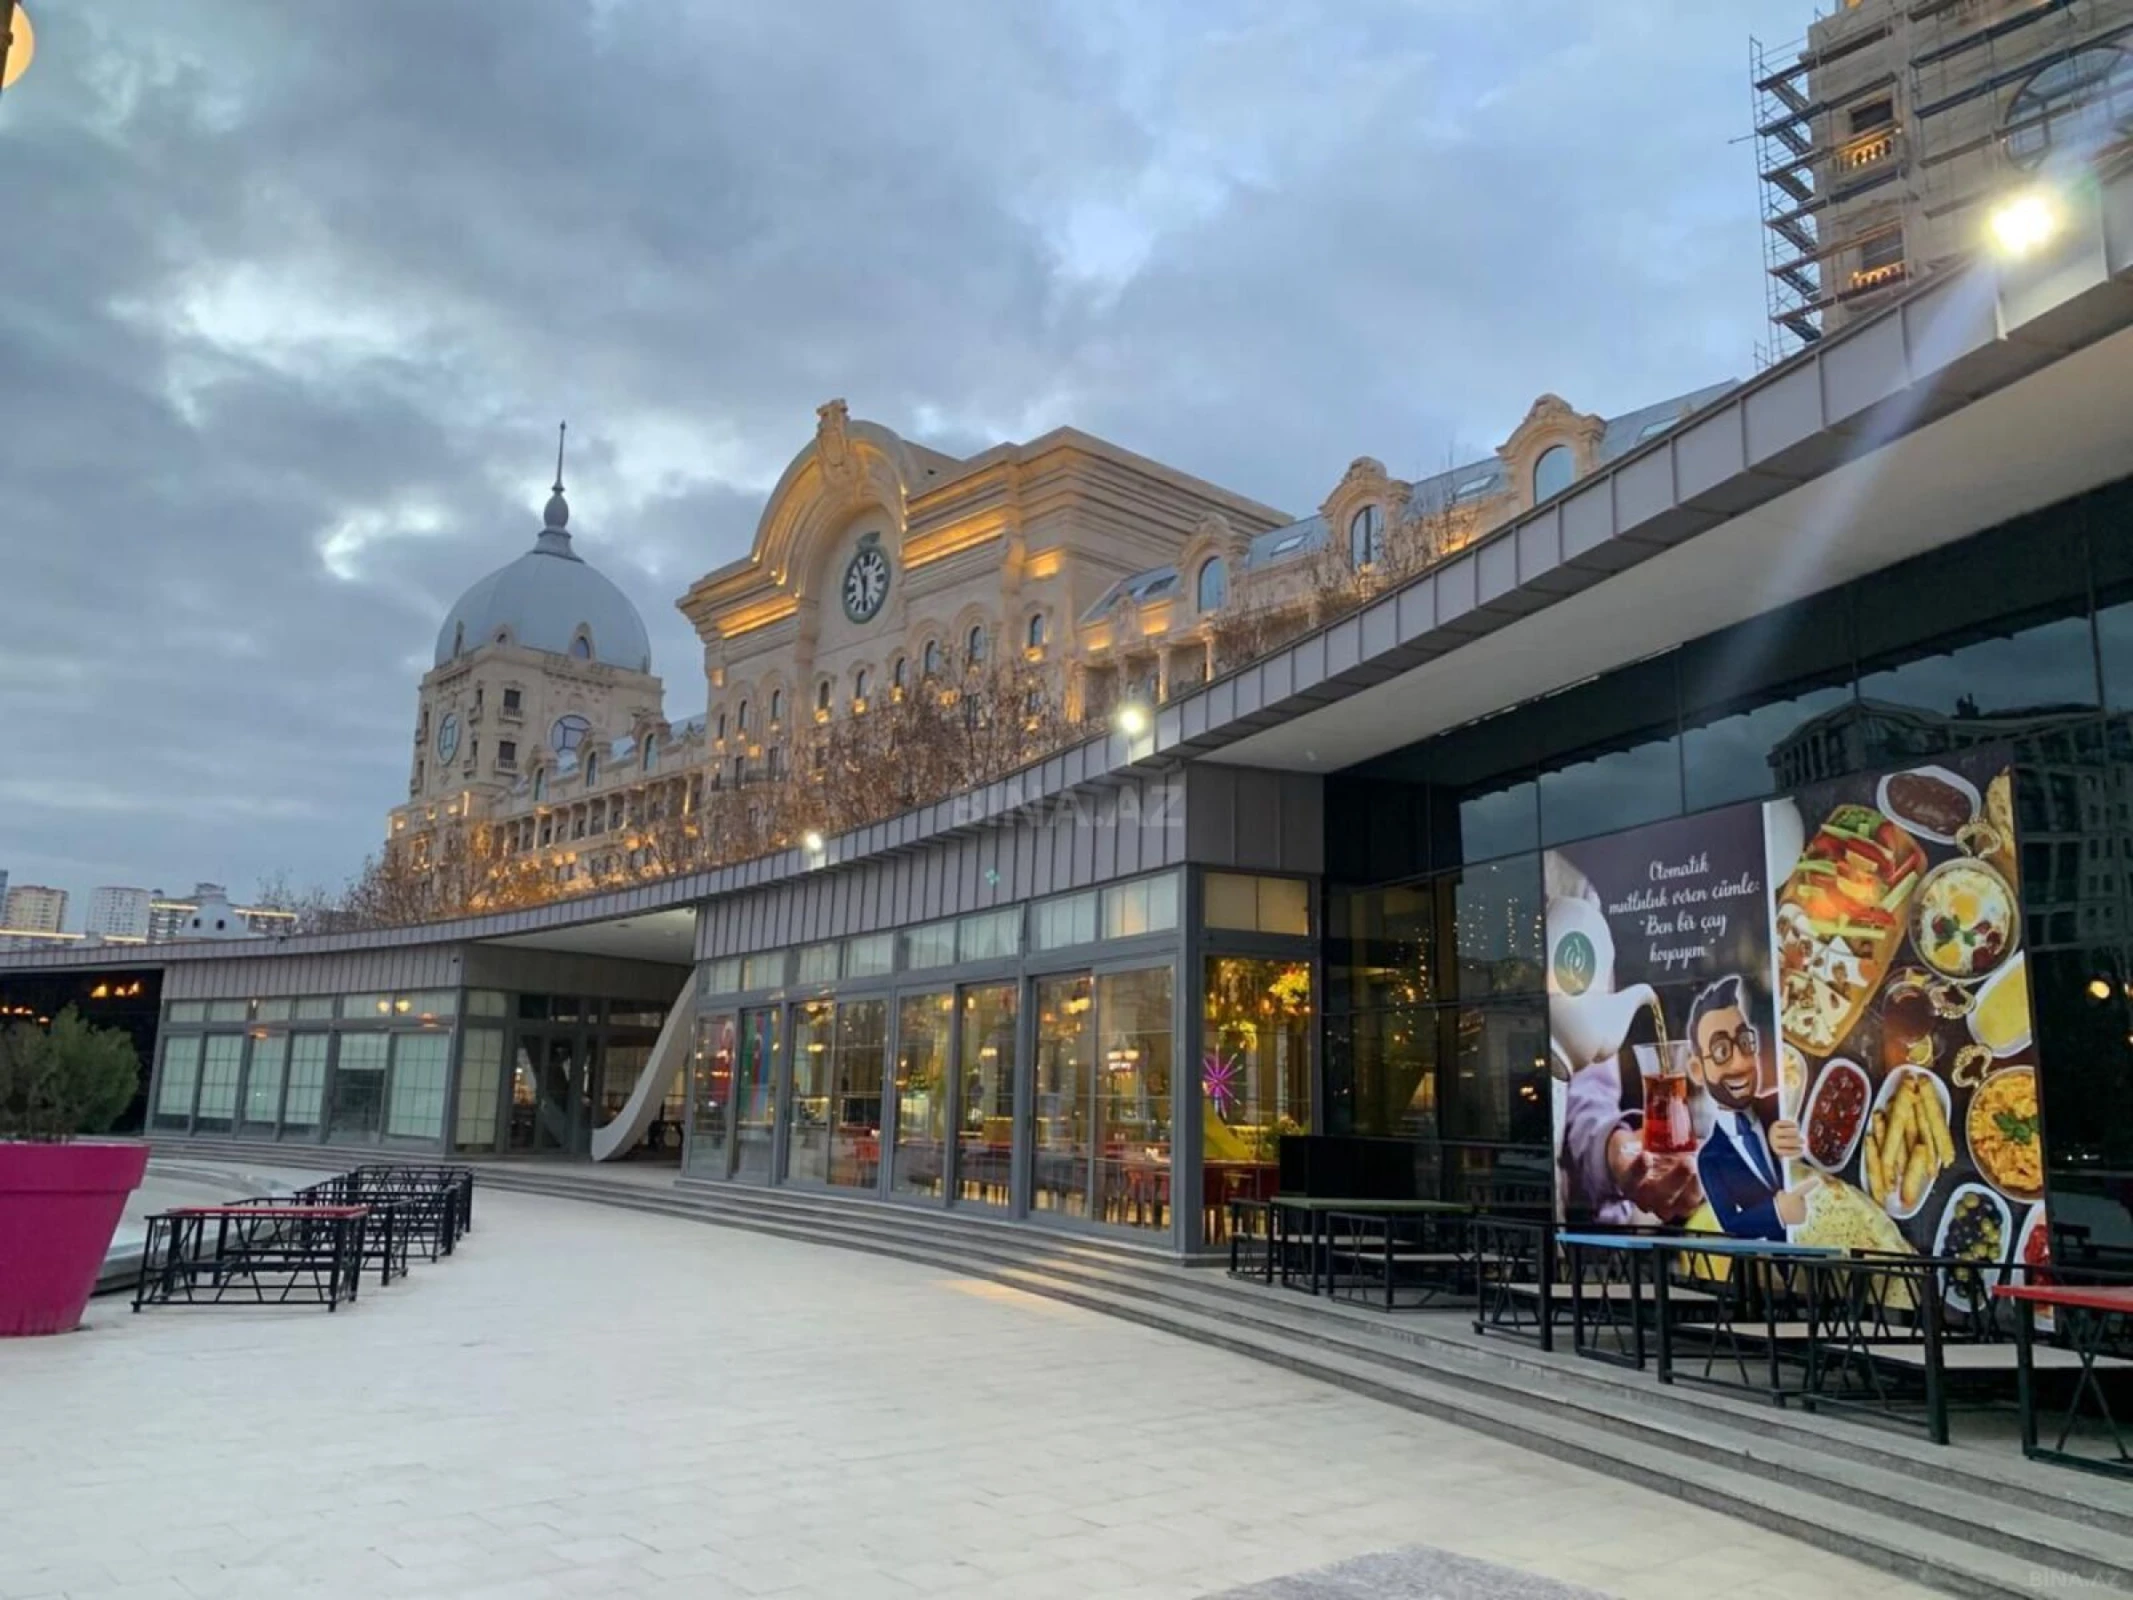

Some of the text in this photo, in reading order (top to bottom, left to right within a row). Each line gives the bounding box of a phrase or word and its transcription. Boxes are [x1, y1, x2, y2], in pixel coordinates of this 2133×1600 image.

[1650, 851, 1710, 881] Otomatik
[1608, 871, 1760, 915] mutluluk veren cümle:
[1677, 909, 1696, 932] bir
[1700, 914, 1727, 937] çay
